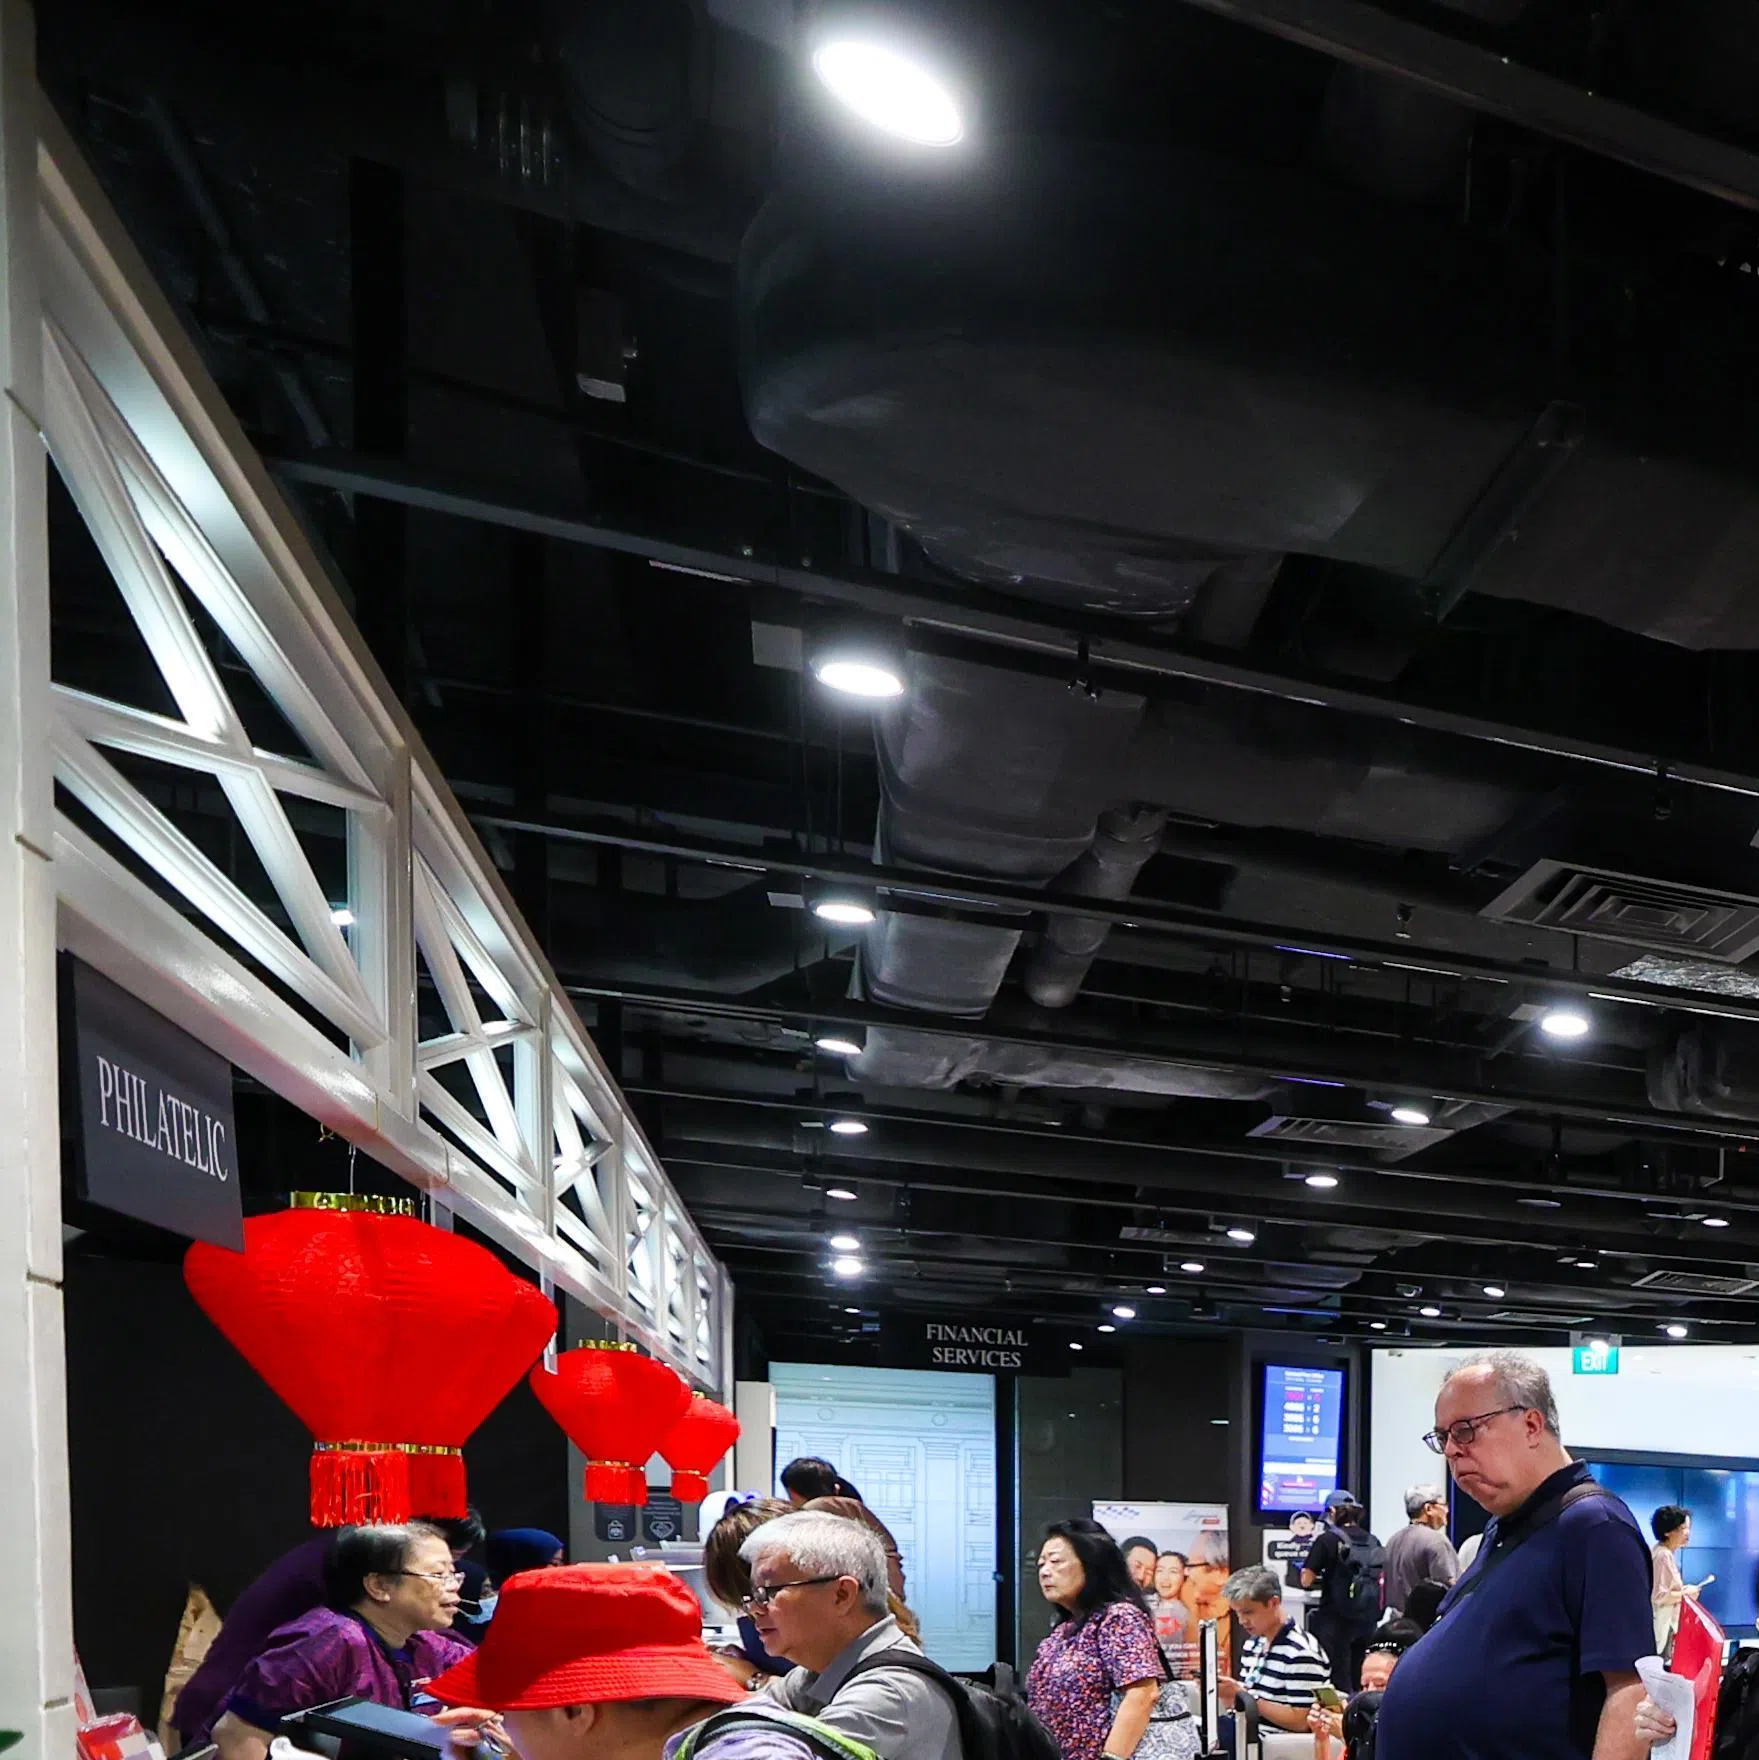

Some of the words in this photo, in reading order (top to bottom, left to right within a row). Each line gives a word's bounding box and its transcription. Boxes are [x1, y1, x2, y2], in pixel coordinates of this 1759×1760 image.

[96, 1055, 229, 1182] PHILATELIC
[926, 1323, 1029, 1346] FINANCIAL
[932, 1346, 1021, 1367] SERVICES
